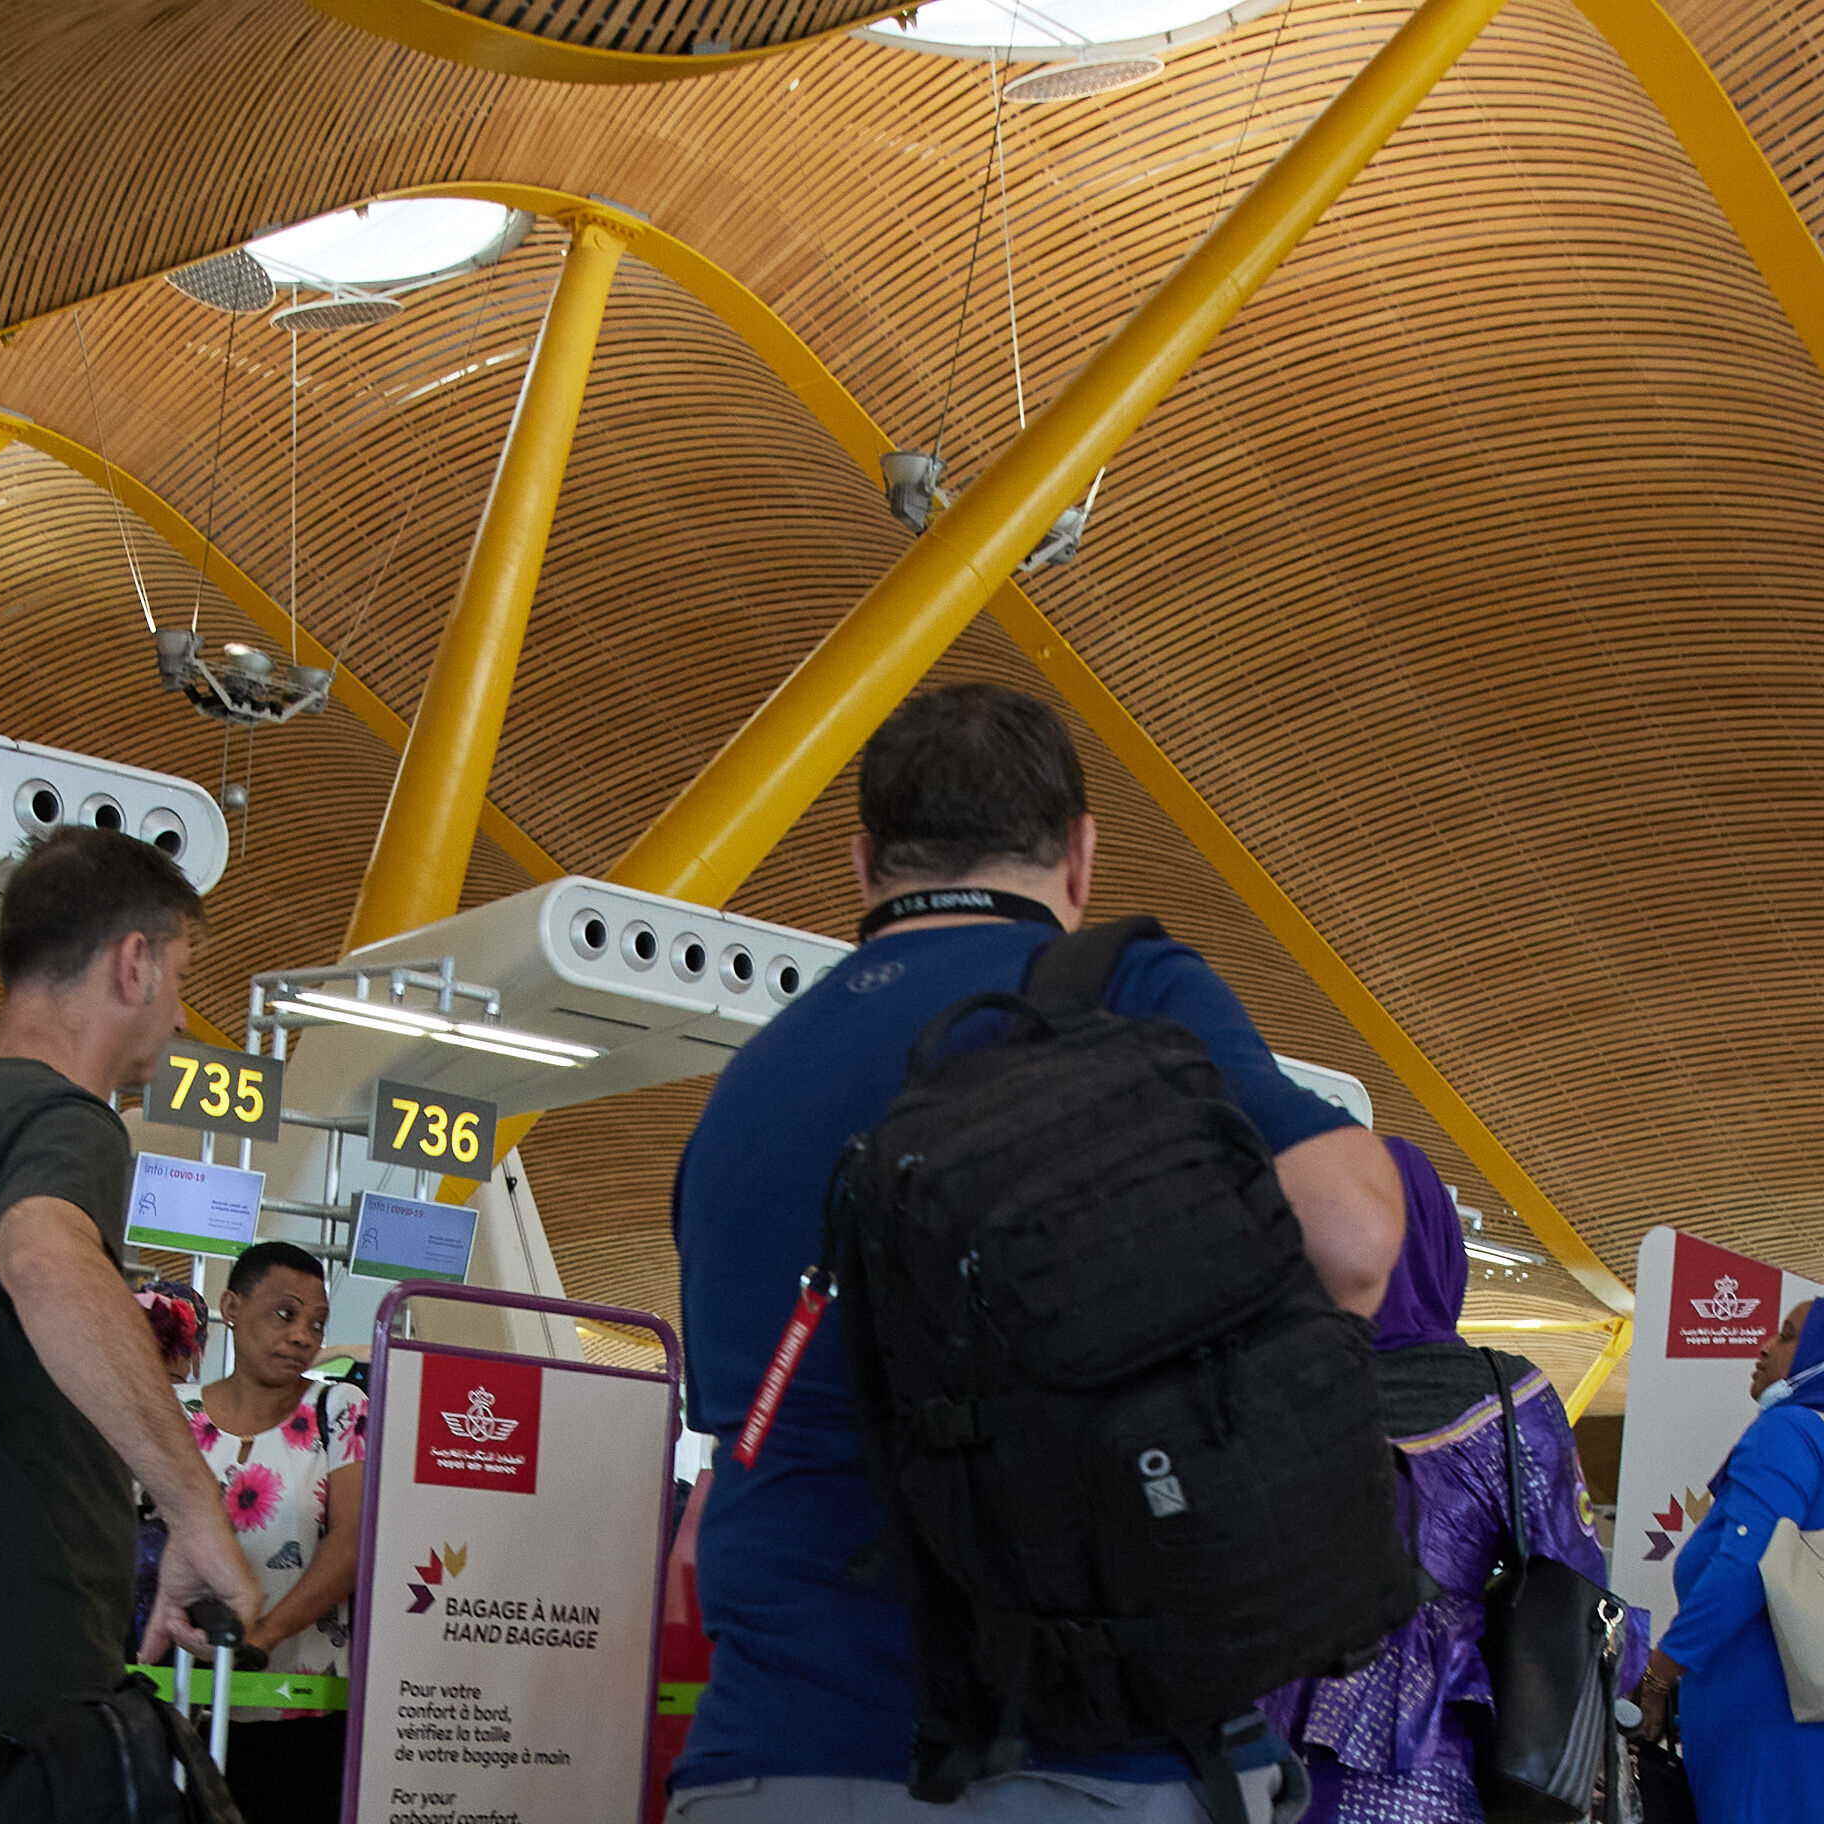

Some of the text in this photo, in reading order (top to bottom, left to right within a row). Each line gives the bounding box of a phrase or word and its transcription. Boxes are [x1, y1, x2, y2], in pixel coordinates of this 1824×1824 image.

[170, 1055, 264, 1123] 735
[391, 1097, 479, 1163] 736
[144, 1162, 205, 1182] info COVID-19
[437, 1458, 465, 1470] royal
[484, 1463, 517, 1476] maroc
[445, 1597, 601, 1625] BAGAGE À MAIN
[443, 1622, 599, 1650] HAND BAGGAGE
[400, 1680, 482, 1700] Pour votre
[398, 1702, 512, 1724] confort à bord,
[396, 1723, 511, 1743] vérifiez la taille
[394, 1745, 572, 1769] de votre bagage à main
[391, 1787, 458, 1810] For your
